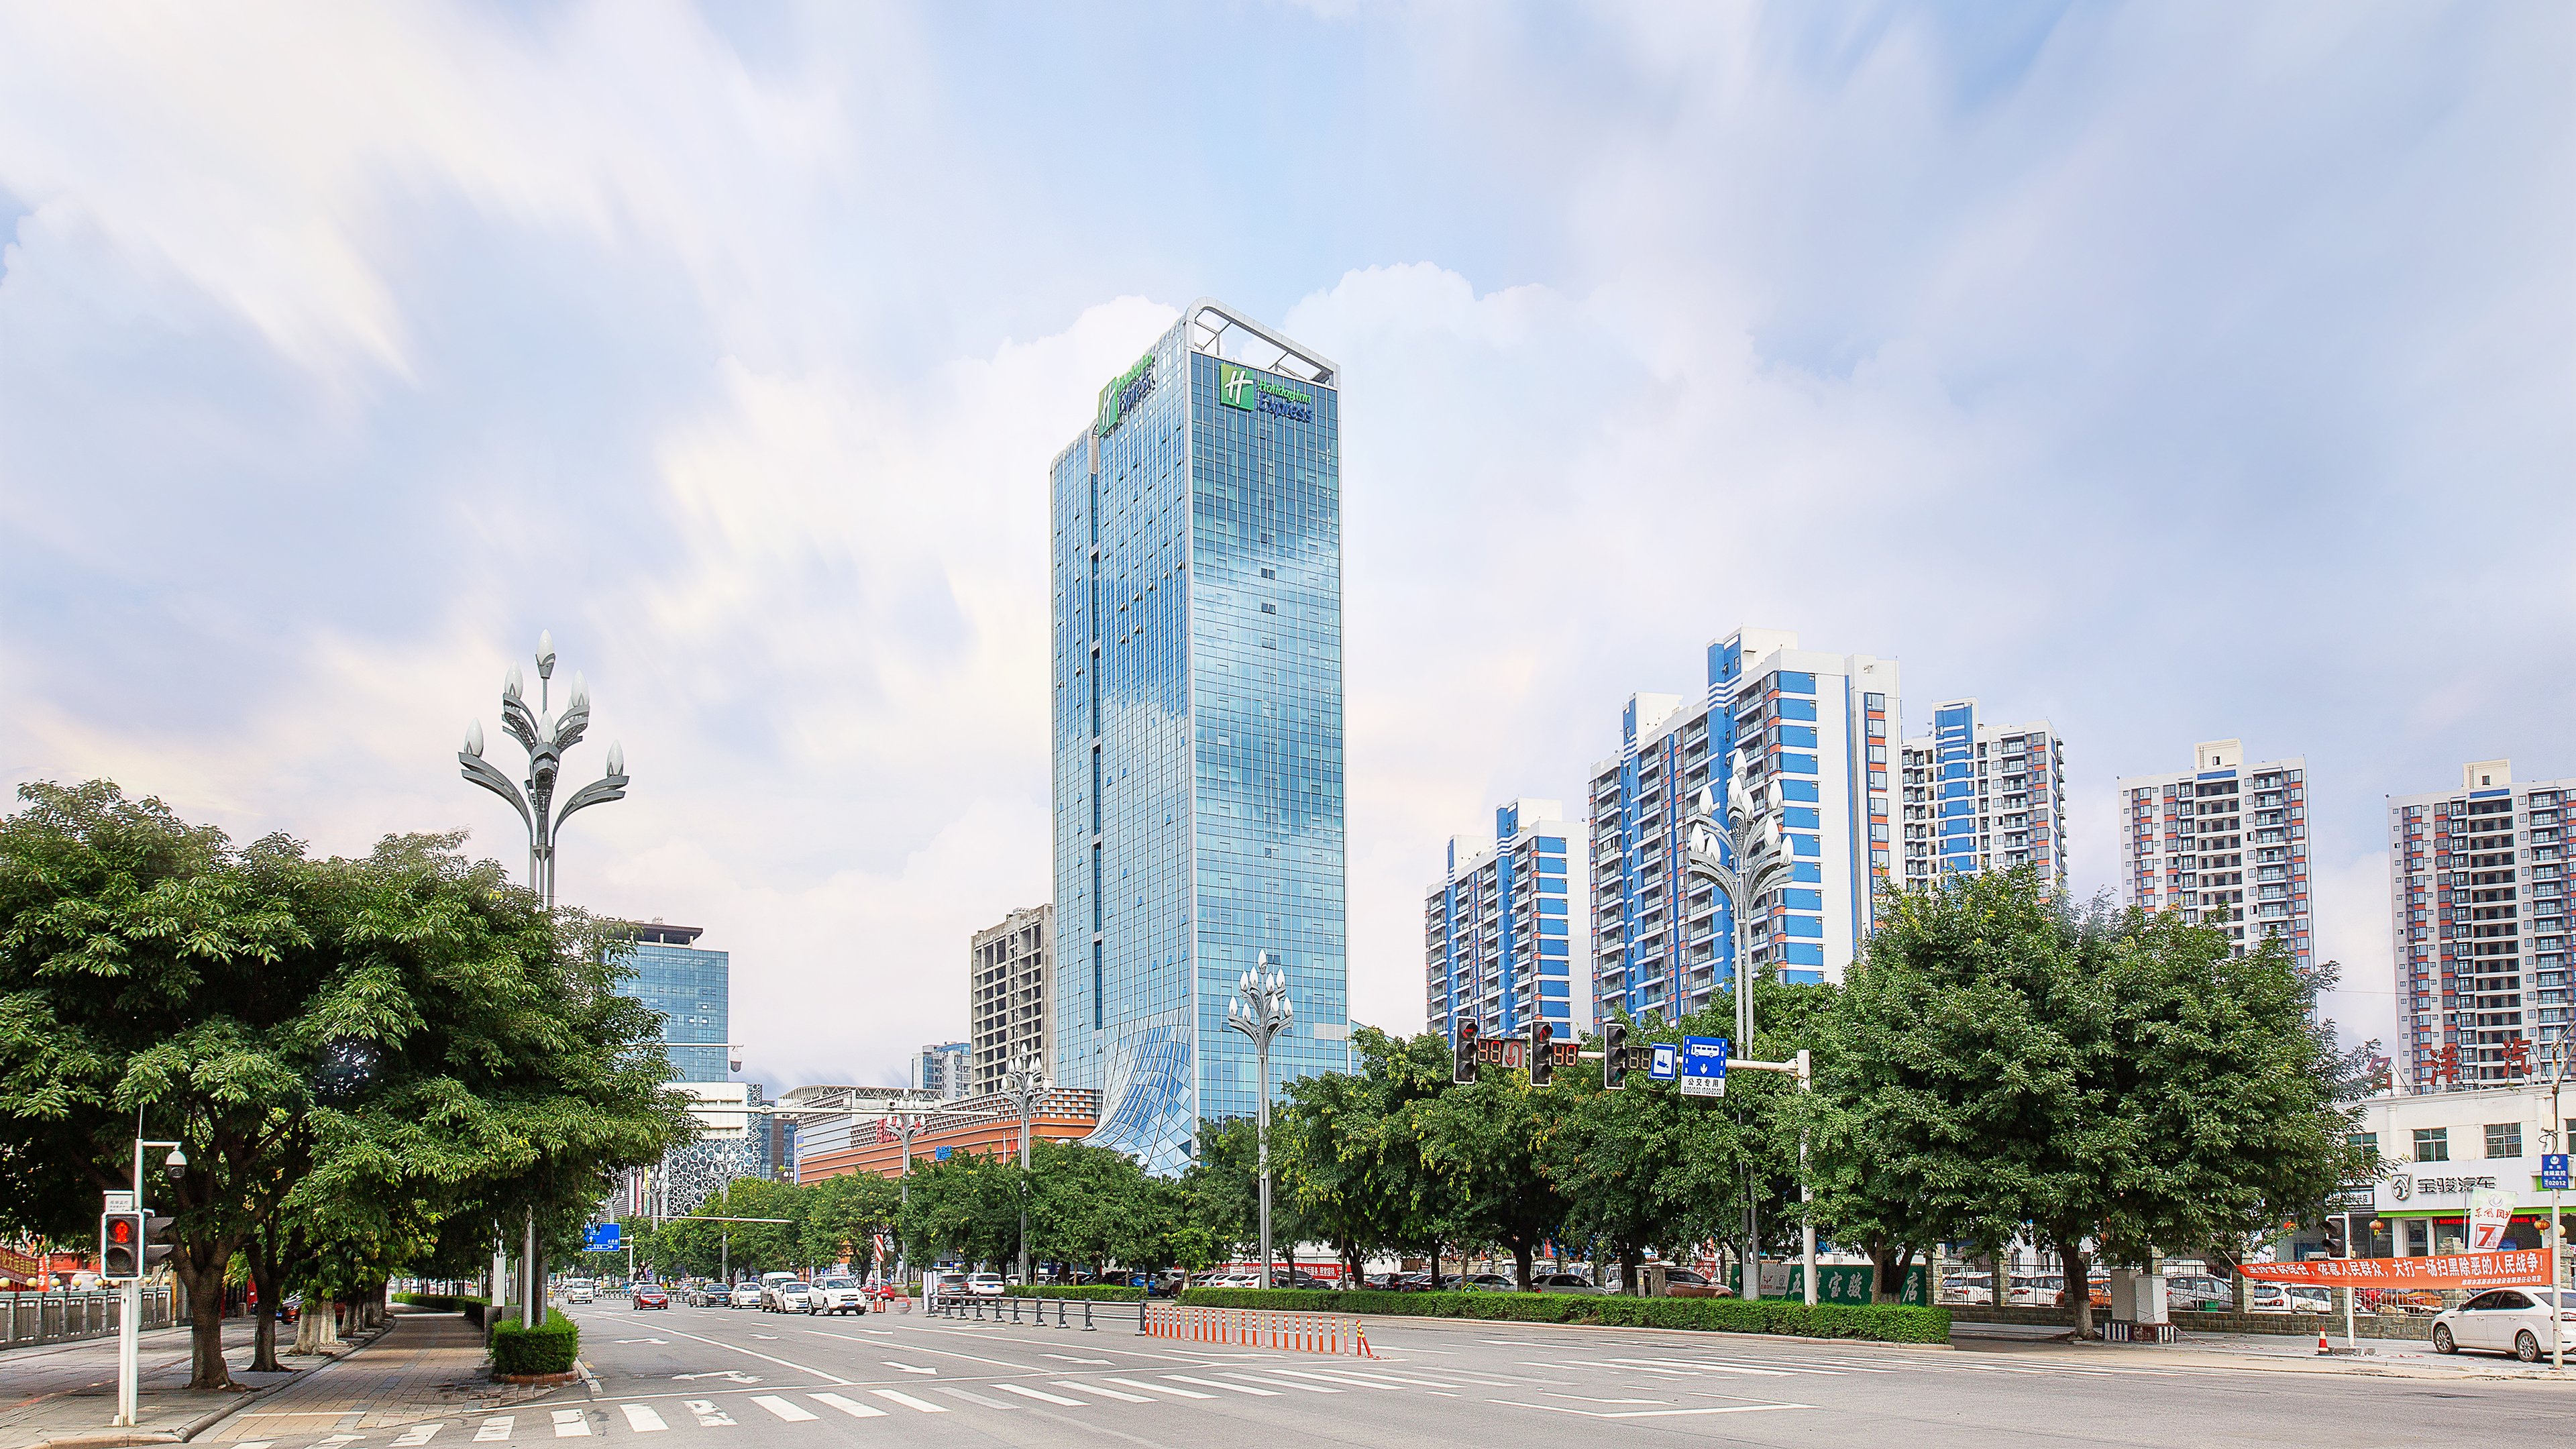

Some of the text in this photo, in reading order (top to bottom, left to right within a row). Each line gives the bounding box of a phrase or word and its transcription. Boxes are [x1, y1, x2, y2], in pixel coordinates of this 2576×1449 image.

[1258, 379, 1311, 405] Holiday Inn
[1259, 391, 1313, 422] Express
[1478, 1040, 1501, 1063] 40
[1553, 1044, 1576, 1066] 40
[1688, 1077, 1719, 1087] 公交专用
[2418, 1176, 2496, 1193] 宝骏汽车
[2477, 1226, 2496, 1247] 7
